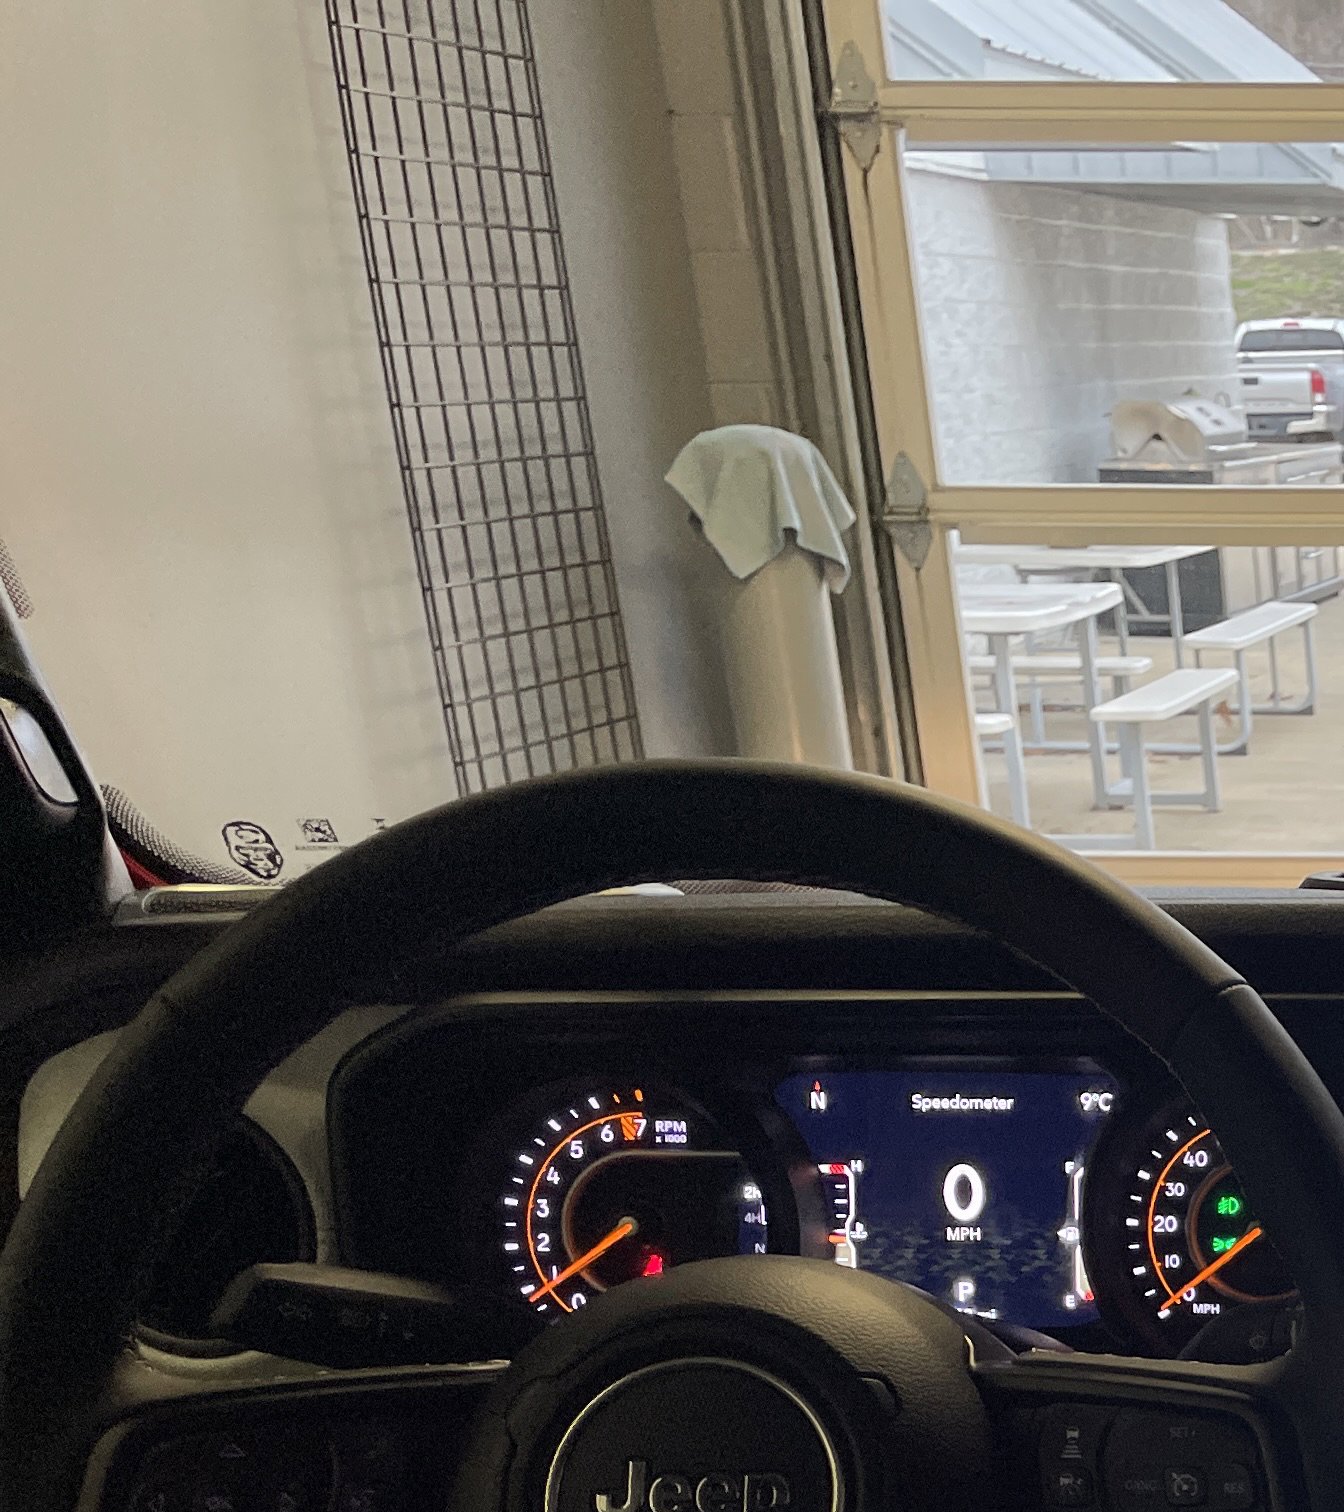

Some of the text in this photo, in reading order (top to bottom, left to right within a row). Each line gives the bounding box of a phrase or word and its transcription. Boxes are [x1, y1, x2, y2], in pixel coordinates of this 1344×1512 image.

[810, 1092, 826, 1109] N
[911, 1093, 1015, 1112] Speedometer
[600, 1124, 614, 1142] 6
[632, 1119, 647, 1137] 7
[655, 1120, 687, 1134] RPM
[665, 1134, 687, 1143] 1000
[570, 1140, 584, 1159] 5
[1182, 1151, 1208, 1167] 40
[546, 1166, 560, 1185] 4
[943, 1163, 986, 1221] 0
[1165, 1182, 1185, 1197] 30
[536, 1199, 549, 1217] 3
[1154, 1215, 1178, 1232] 20
[537, 1233, 550, 1252] 2
[946, 1227, 982, 1241] MPH
[1164, 1254, 1181, 1268] 10
[958, 1281, 975, 1302] P
[1193, 1303, 1220, 1315] MPH
